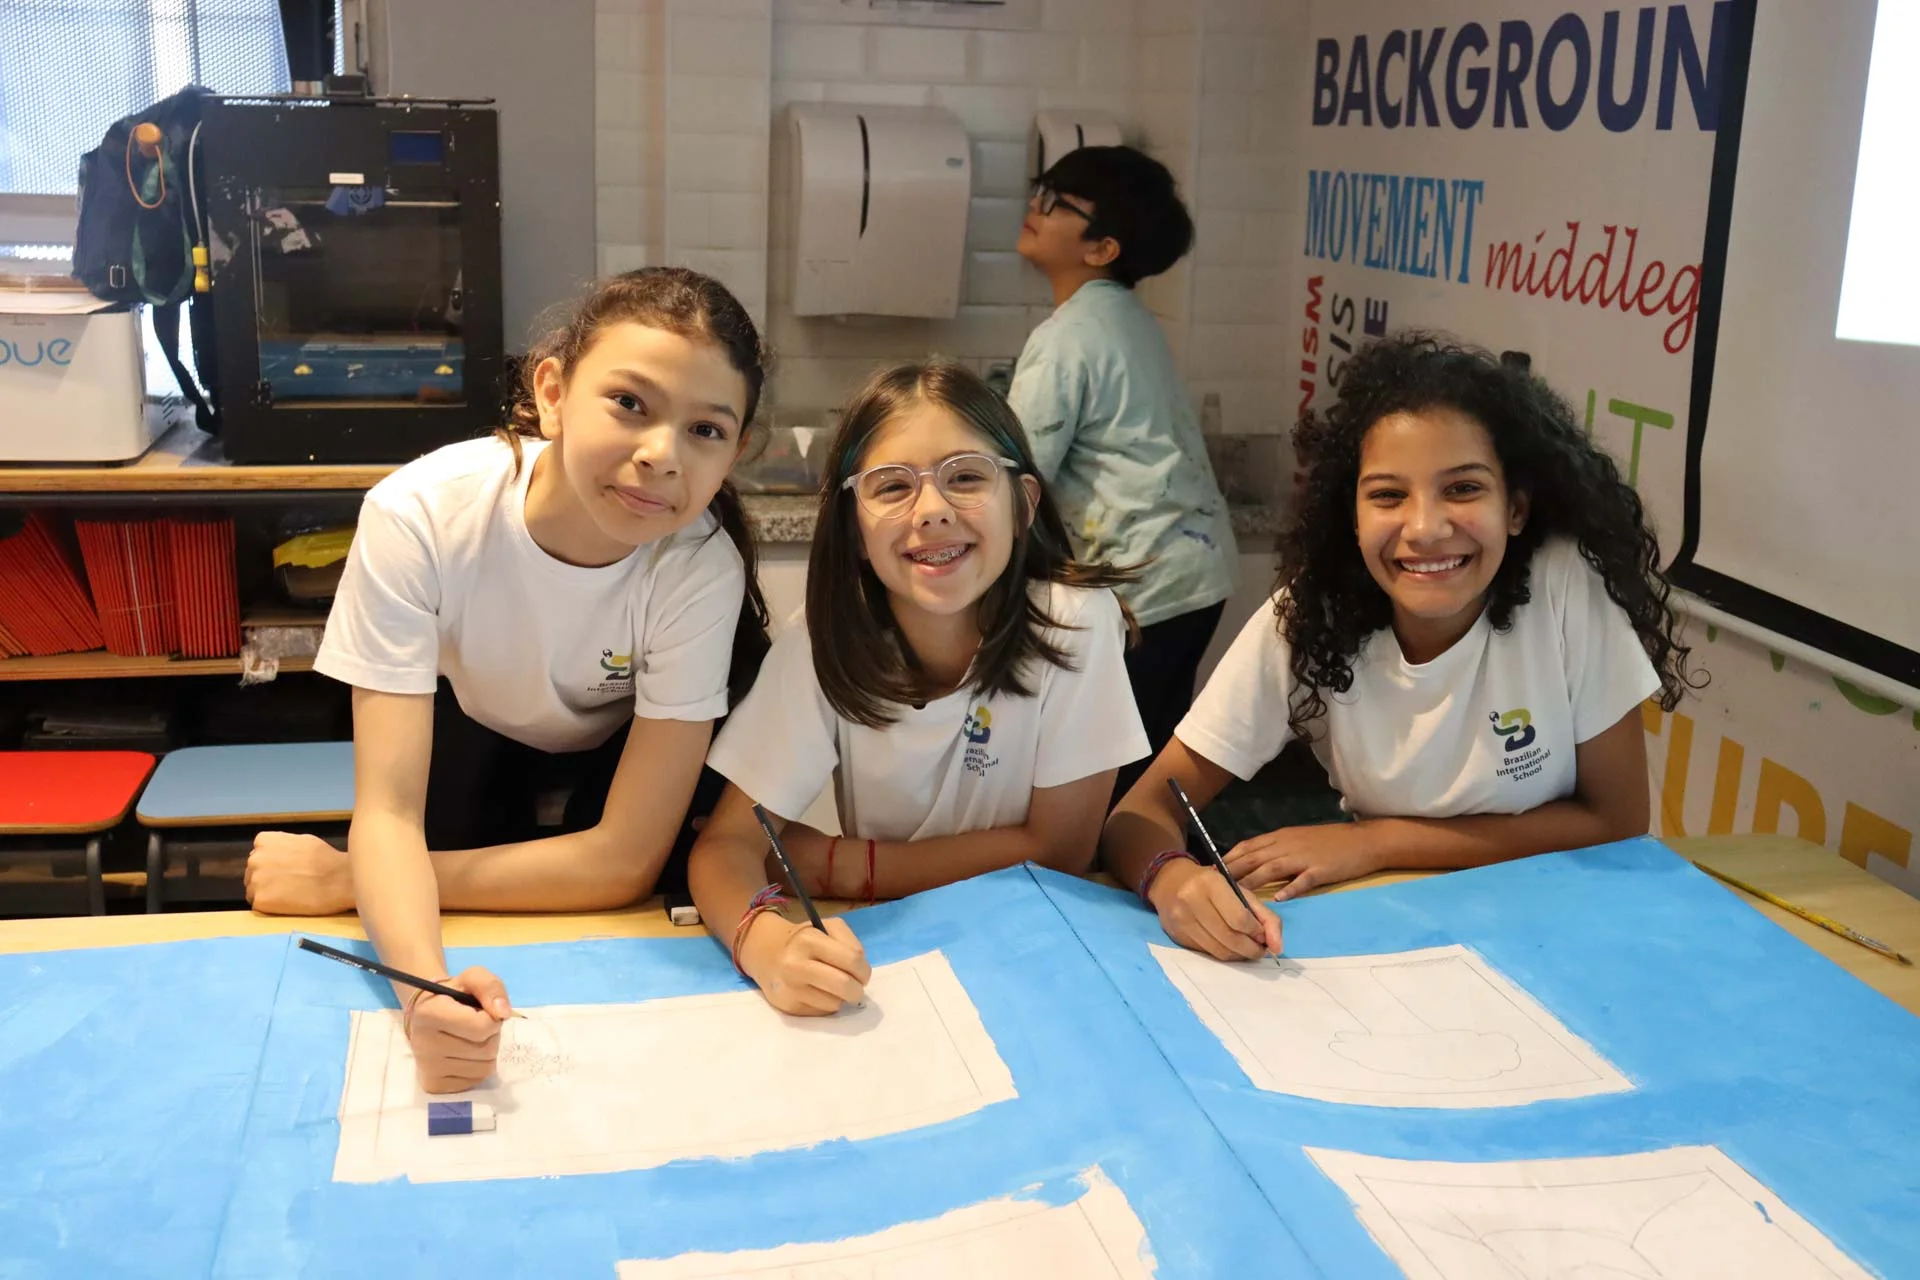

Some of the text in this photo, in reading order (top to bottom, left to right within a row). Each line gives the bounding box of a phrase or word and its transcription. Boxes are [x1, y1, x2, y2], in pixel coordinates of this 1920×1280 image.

[1312, 1, 1727, 132] BACKGROUN
[1305, 170, 1484, 284] MOVEMENT
[1496, 748, 1551, 777] International
[1504, 747, 1541, 766] Brazilian
[1513, 764, 1542, 782] School
